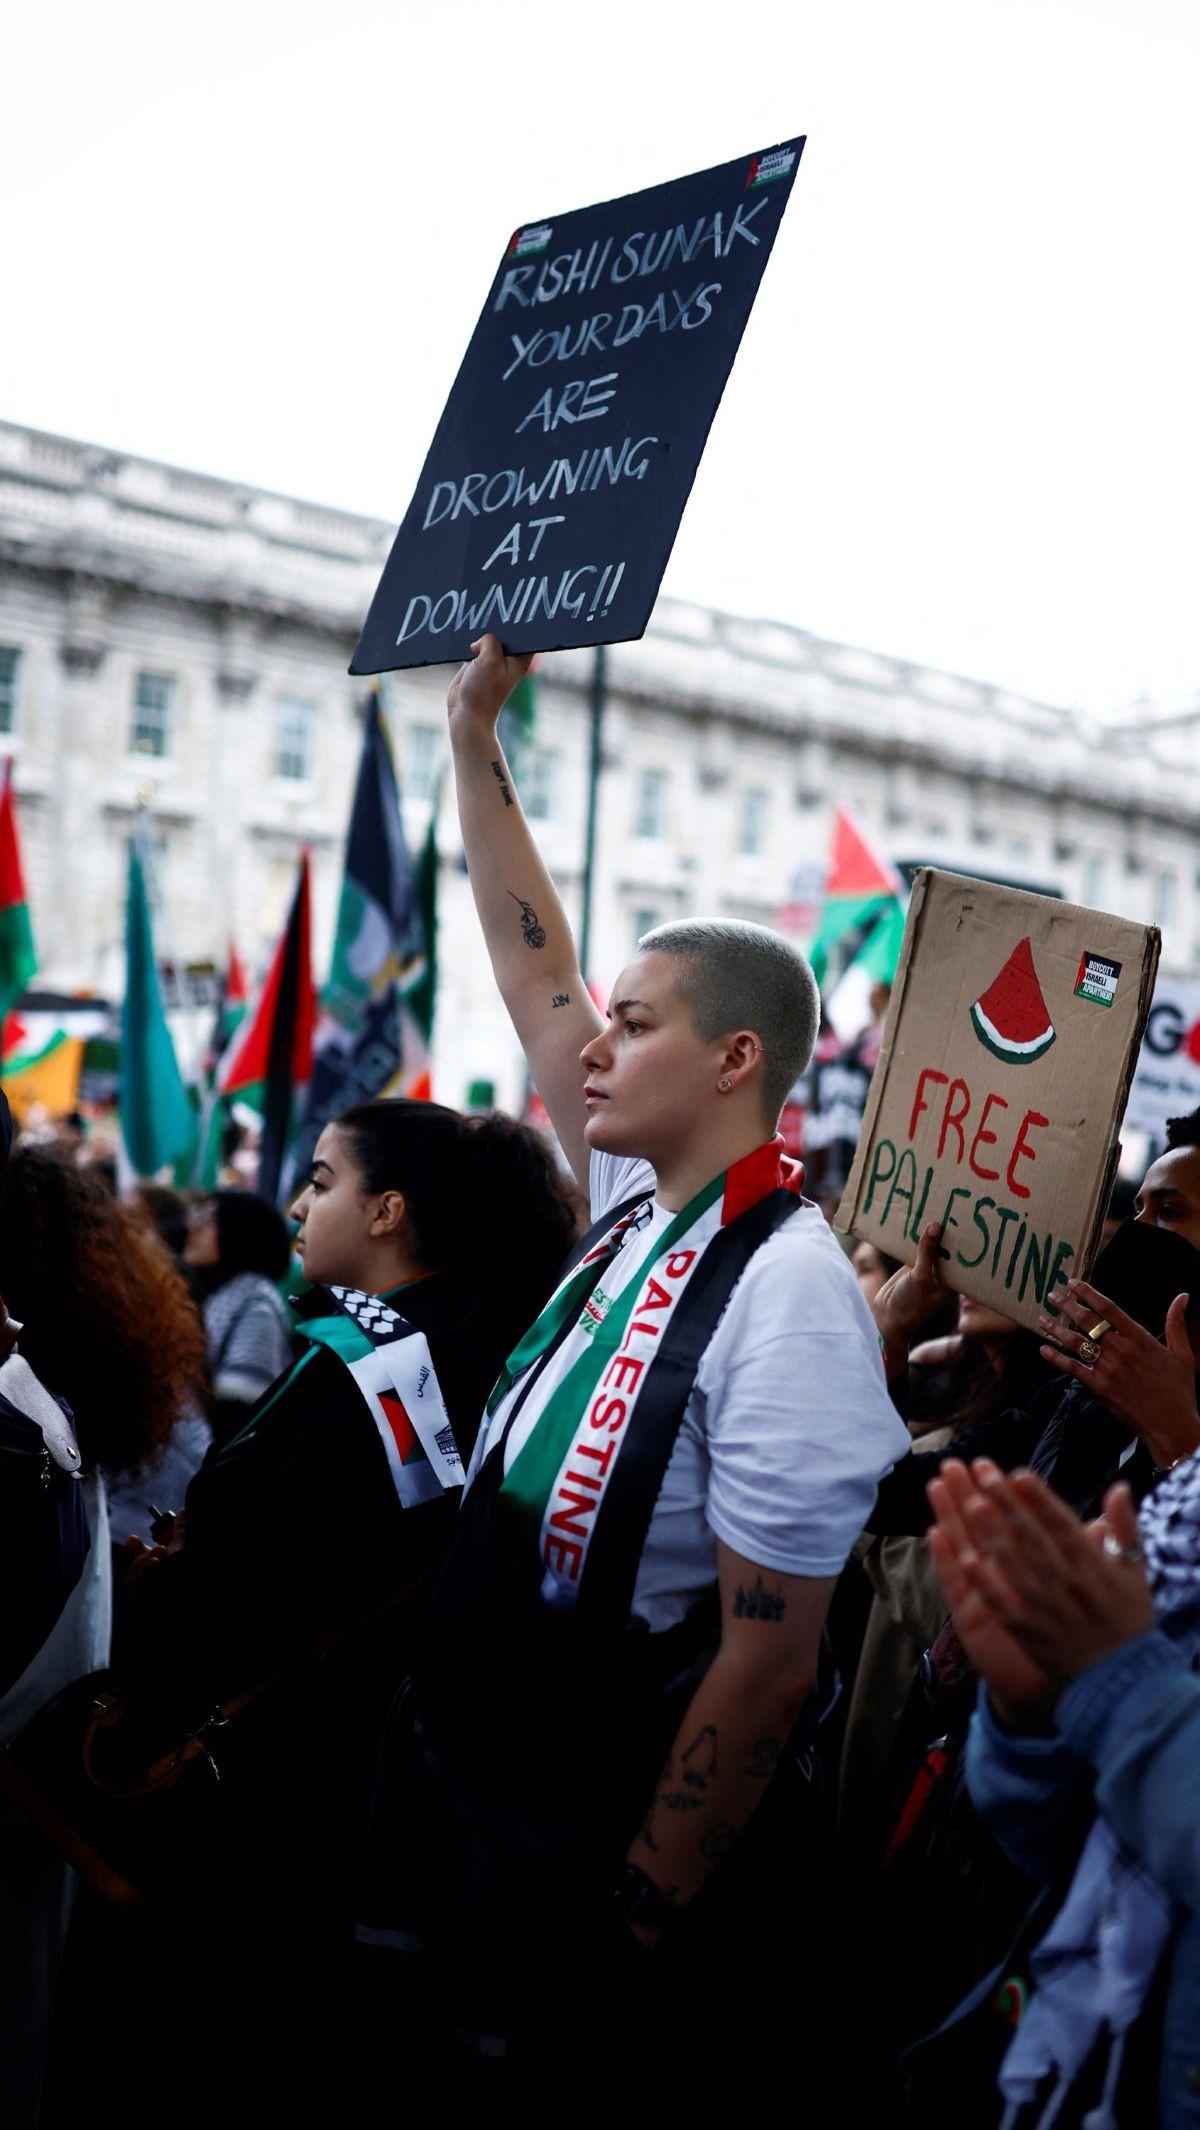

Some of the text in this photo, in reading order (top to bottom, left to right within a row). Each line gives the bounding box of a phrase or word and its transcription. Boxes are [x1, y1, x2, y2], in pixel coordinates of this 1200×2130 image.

[494, 197, 769, 312] RISHI SUNAK
[502, 282, 722, 381] YOUR DAYS
[515, 372, 619, 433] ARE
[422, 436, 658, 531] DROWNING
[481, 515, 566, 571] AT
[395, 561, 625, 646] DOWNING!!
[1082, 983, 1113, 1001] APARTHEID
[1085, 972, 1107, 987] ISRAELI
[1088, 960, 1114, 976] BOYCOTT
[908, 1068, 1049, 1199] FREE
[544, 1249, 698, 1582] PALESTINE
